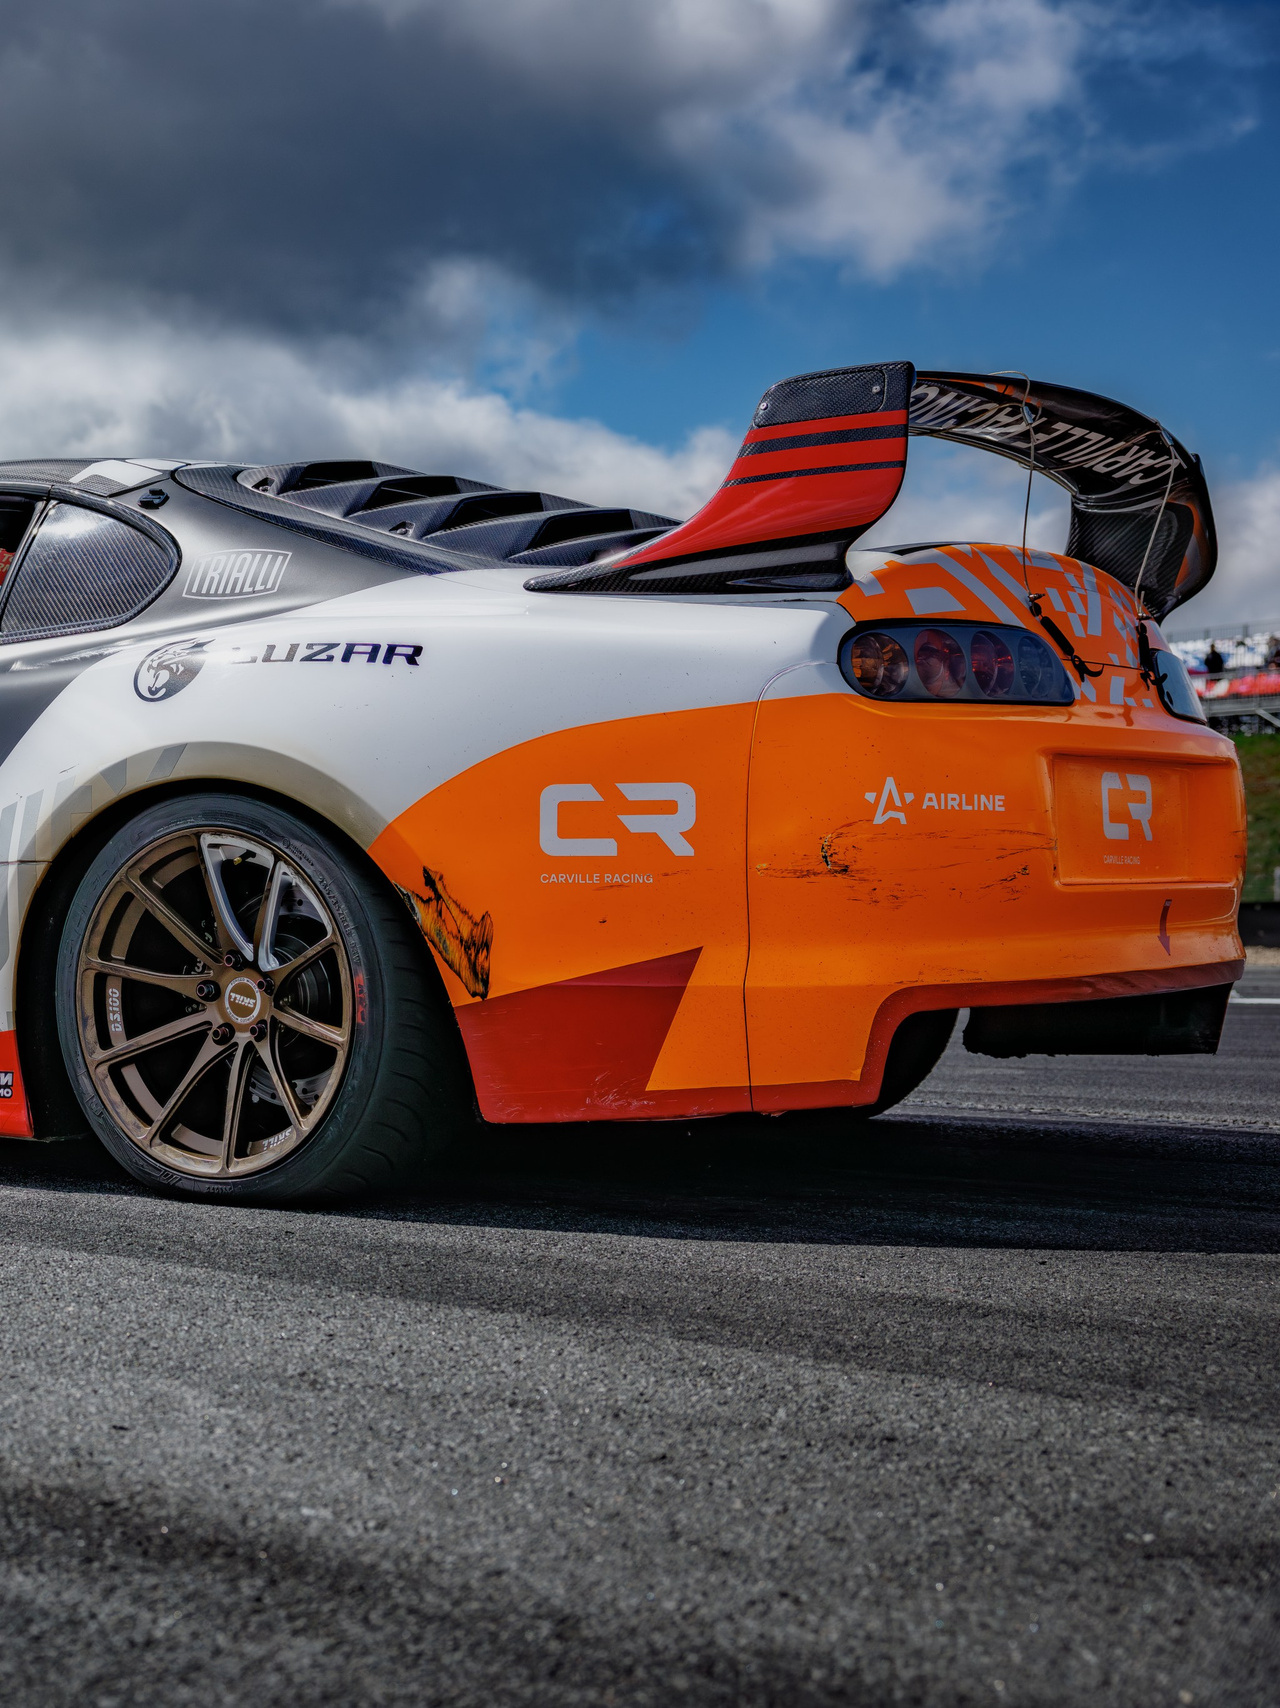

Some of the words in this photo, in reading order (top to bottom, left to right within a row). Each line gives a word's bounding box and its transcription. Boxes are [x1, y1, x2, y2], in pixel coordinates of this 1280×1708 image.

[910, 384, 1048, 442] RACING
[1010, 422, 1180, 486] CARVILLE
[192, 552, 283, 595] TRIALLI
[539, 782, 696, 857] CR
[922, 793, 1006, 812] AIRLINE
[1101, 771, 1153, 842] CR
[540, 873, 600, 884] CARVILLE
[604, 873, 654, 884] RACING
